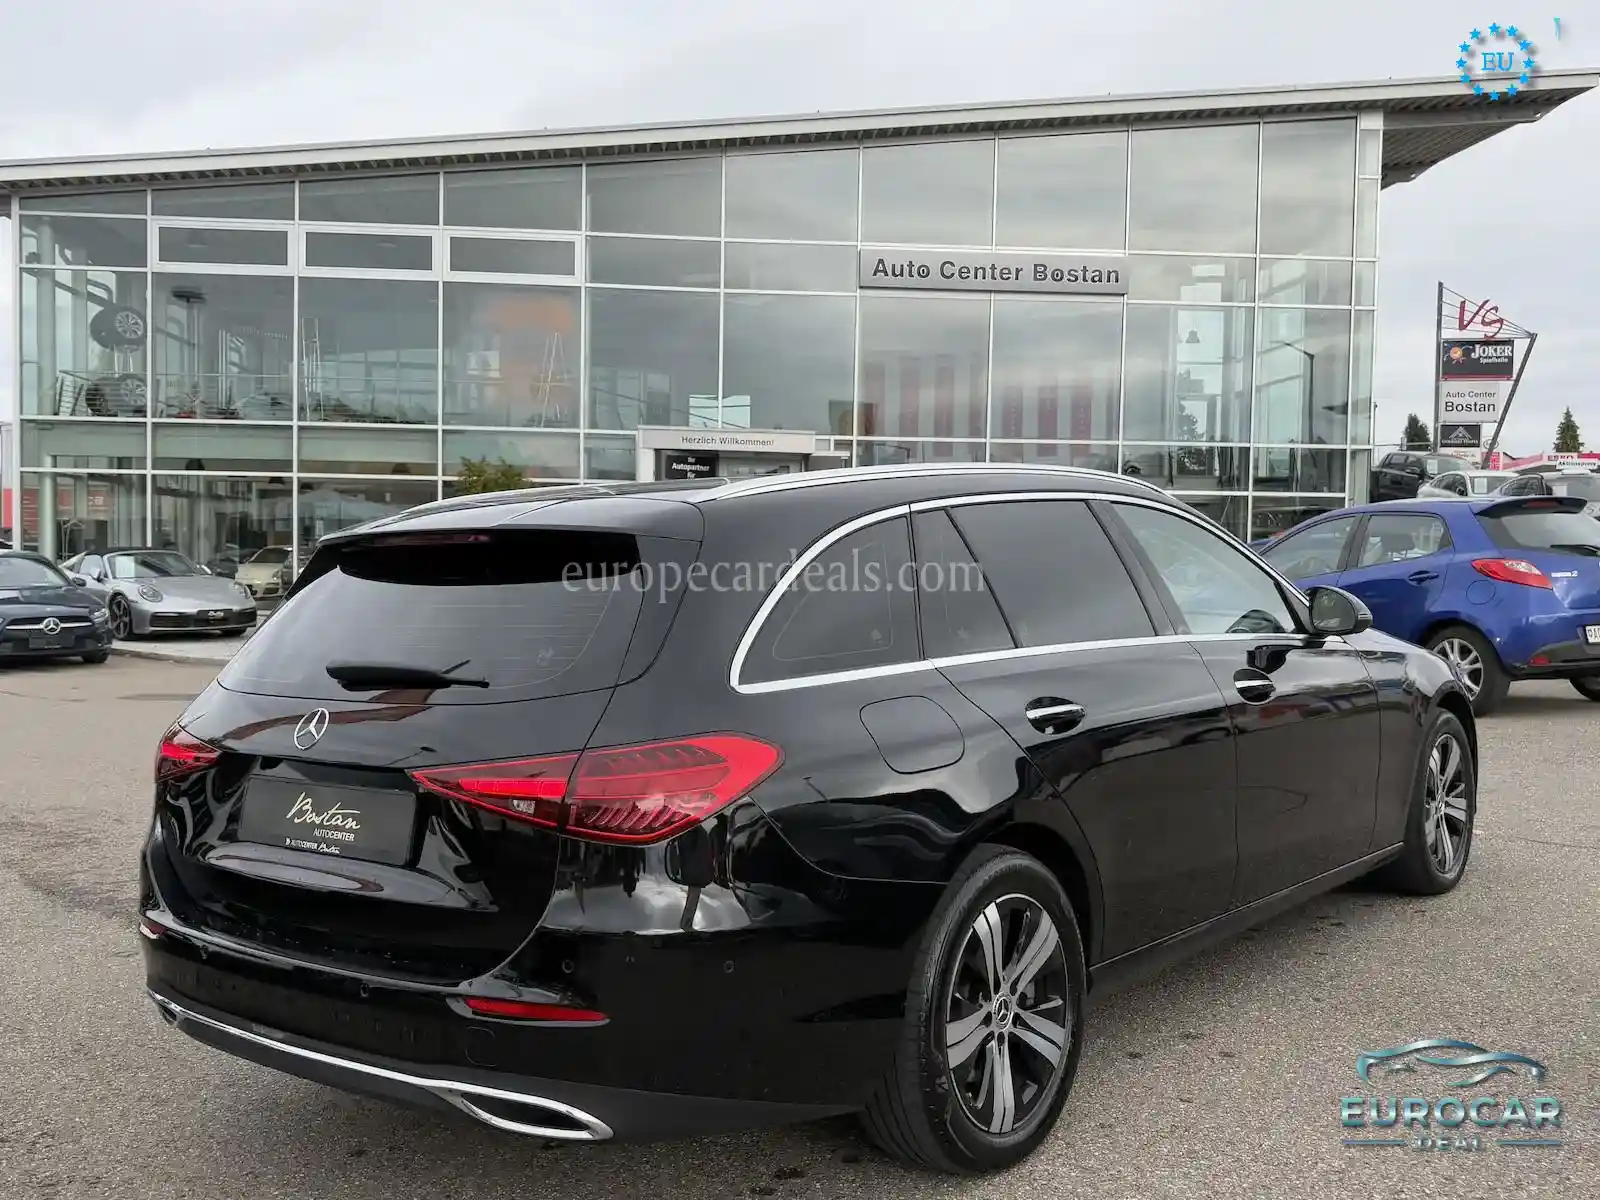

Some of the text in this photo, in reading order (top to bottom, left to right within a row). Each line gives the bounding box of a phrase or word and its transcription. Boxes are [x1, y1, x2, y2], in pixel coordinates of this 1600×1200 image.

[872, 258, 1120, 284] Auto Center Bostan
[1471, 344, 1512, 359] JOKER
[1445, 391, 1496, 399] Auto Center
[1444, 401, 1496, 413] Bostan
[681, 435, 775, 447] Herzlich Willkommen!
[671, 462, 710, 471] Autopartner
[286, 792, 361, 829] Bostan
[313, 828, 355, 841] AUTOCENTER
